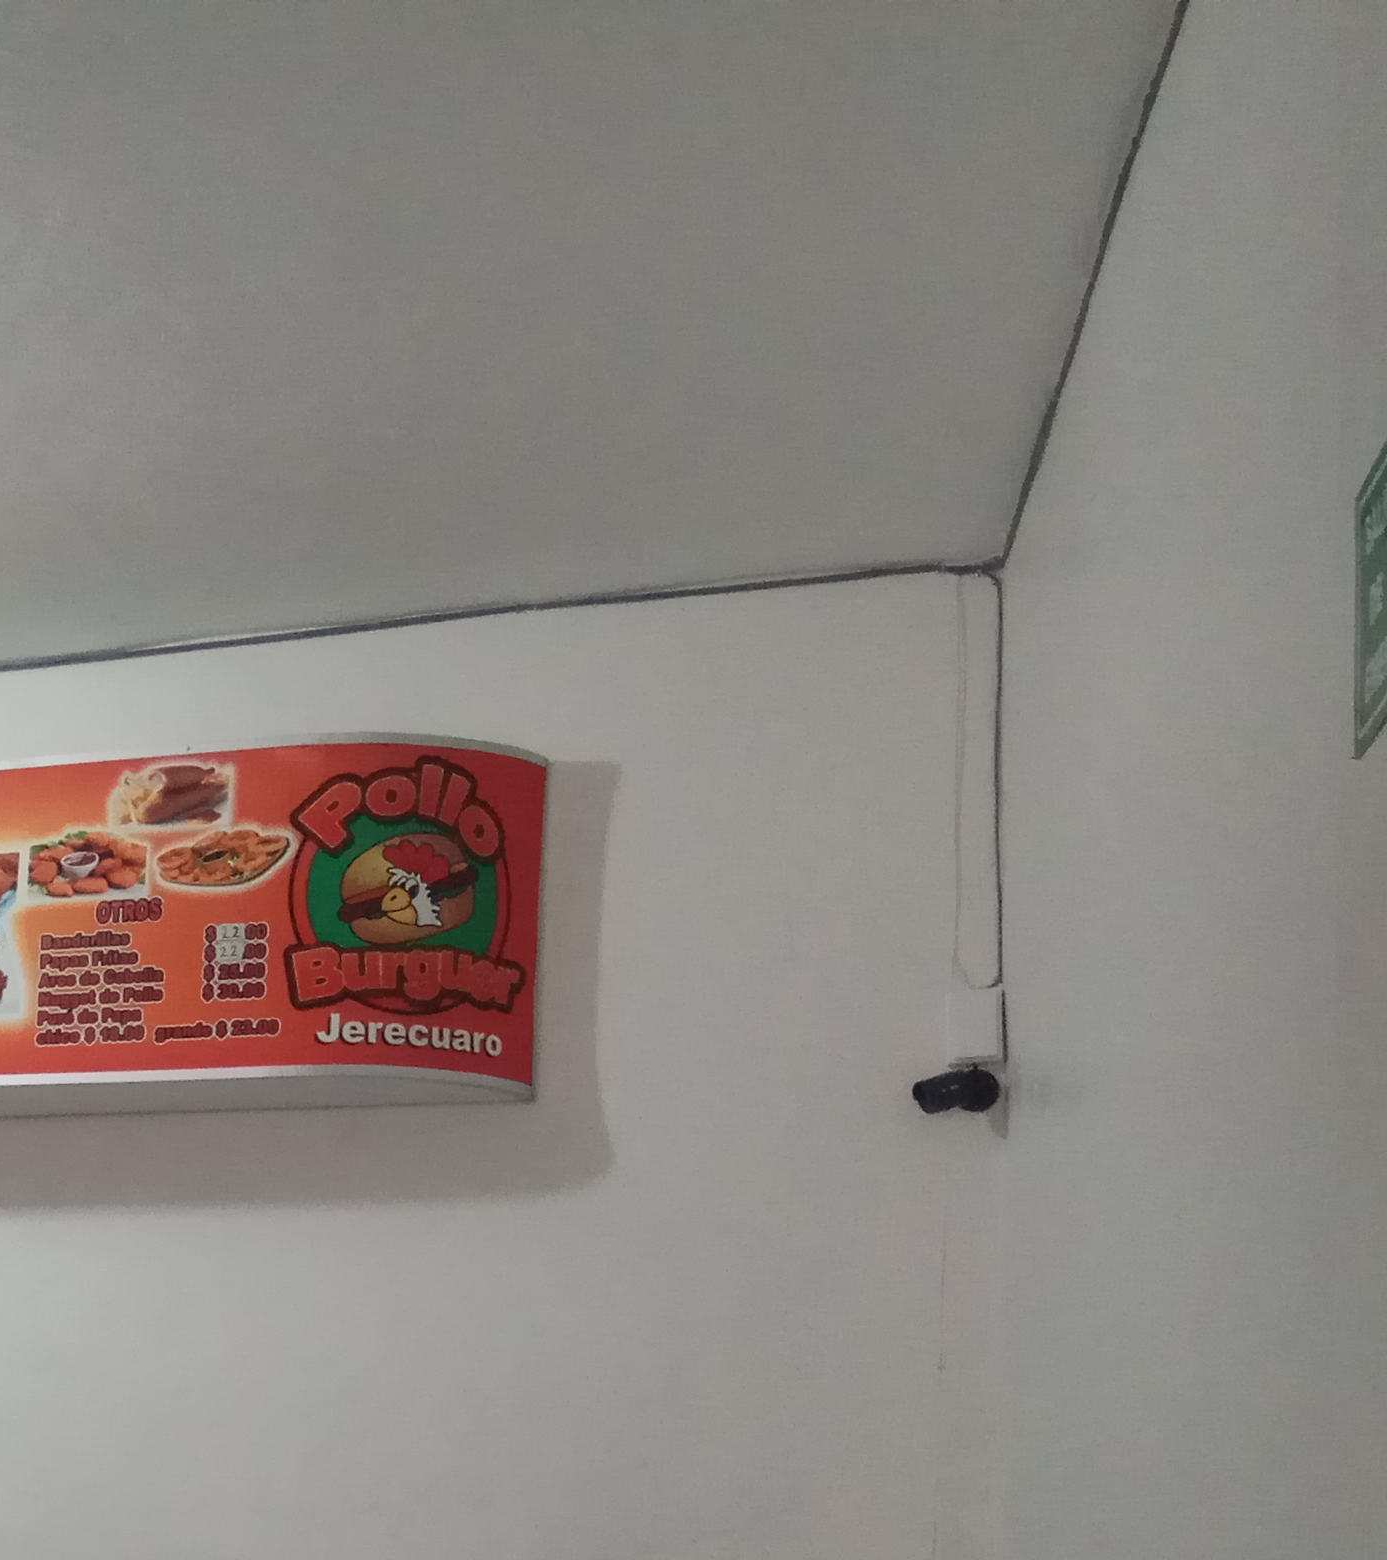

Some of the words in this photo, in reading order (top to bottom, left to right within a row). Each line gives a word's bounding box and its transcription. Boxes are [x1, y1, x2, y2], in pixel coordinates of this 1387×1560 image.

[297, 764, 499, 857] Pollo
[96, 898, 162, 923] OTROS
[41, 932, 130, 949] Banderillas
[41, 955, 89, 968] Papas
[39, 974, 76, 987] Aros
[80, 972, 99, 986] de
[99, 989, 120, 1002] de
[124, 988, 164, 1001] Pollo
[78, 1009, 98, 1023] de
[155, 1024, 212, 1042] grande
[317, 1013, 502, 1056] Jerecuaro
